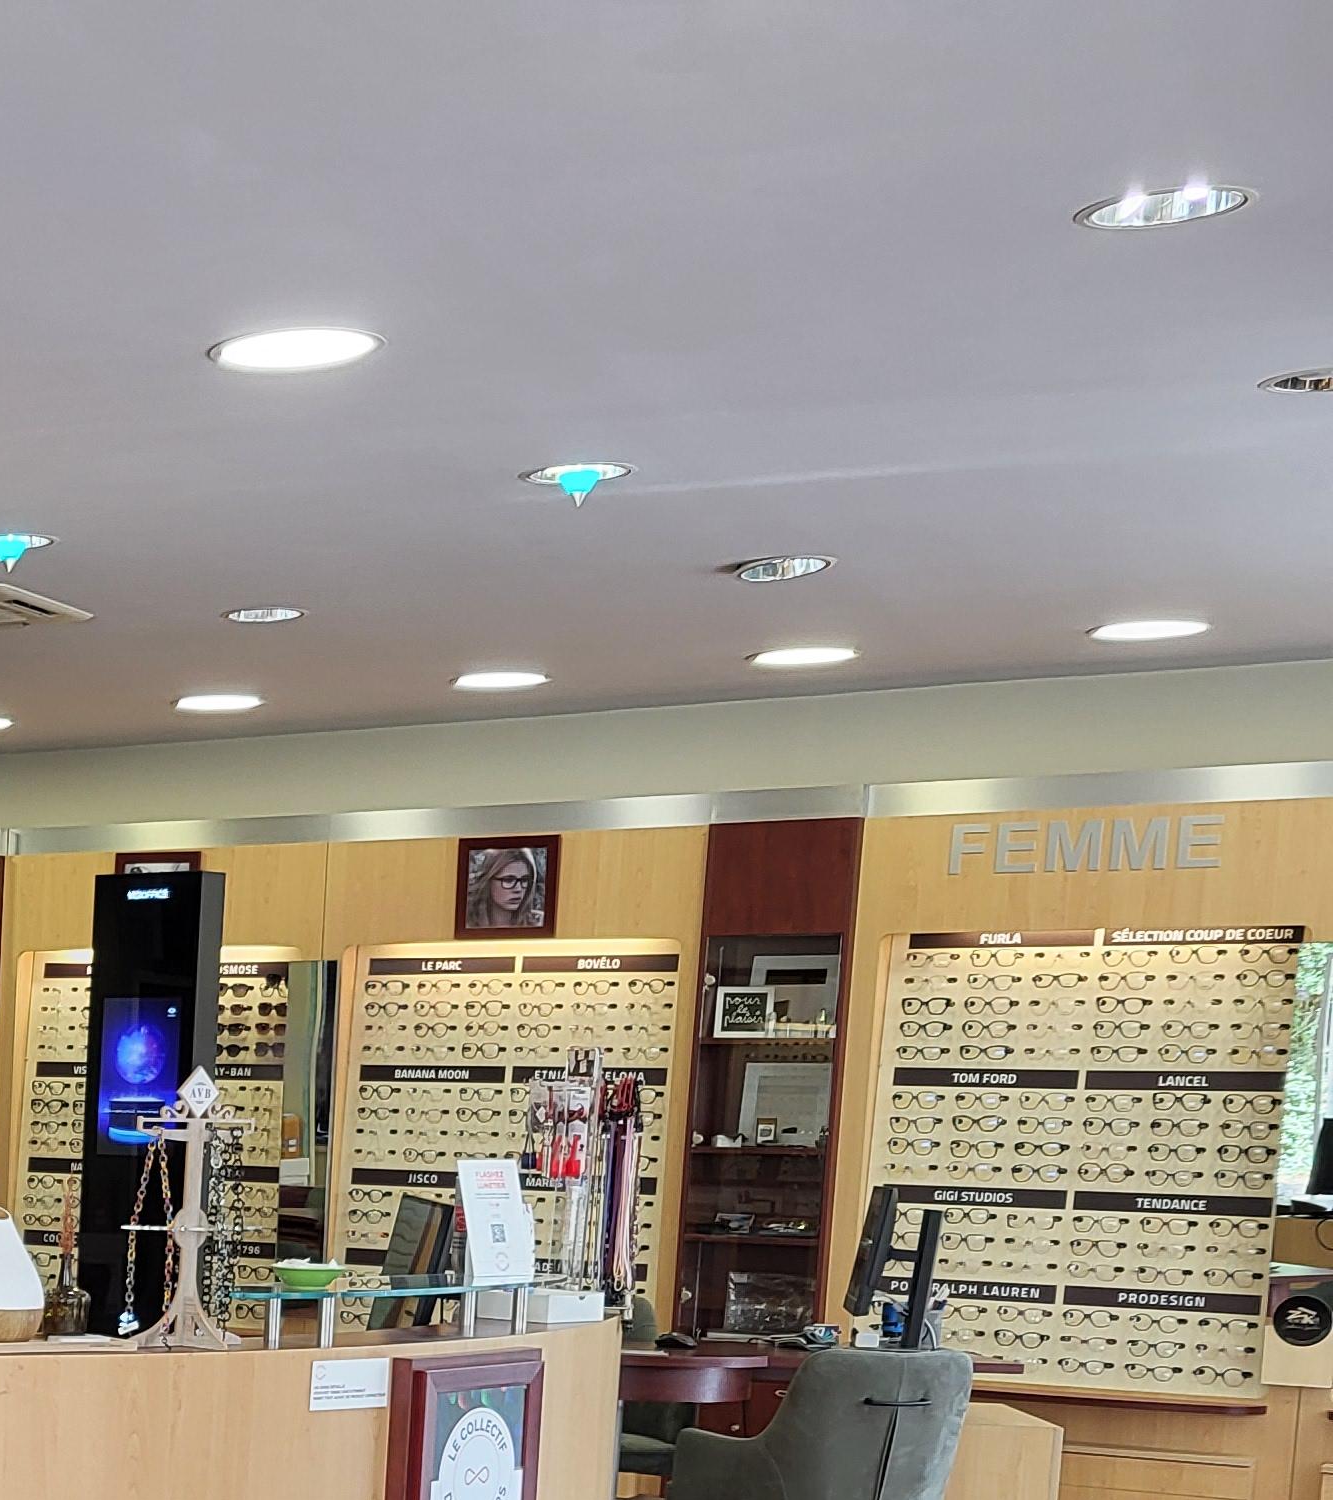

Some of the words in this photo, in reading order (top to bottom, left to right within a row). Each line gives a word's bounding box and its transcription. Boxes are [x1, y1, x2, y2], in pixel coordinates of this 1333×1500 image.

[948, 814, 1225, 875] FEMME
[978, 931, 1022, 945] FURLA
[1111, 927, 1184, 943] SÉLECTION
[1185, 929, 1221, 943] COUP
[1222, 929, 1244, 942] DE
[1246, 928, 1294, 942] COEUR
[421, 961, 434, 971] LE
[435, 959, 463, 971] PARC
[725, 996, 762, 1009] pour
[735, 1004, 751, 1017] le
[724, 1010, 764, 1028] plaisir
[394, 1068, 434, 1080] BANANA
[437, 1068, 470, 1080] MOON
[952, 1072, 980, 1084] TOM
[982, 1072, 1017, 1085] FORD
[1157, 1074, 1209, 1088] LANCEL
[189, 1088, 212, 1100] AVB
[407, 1172, 439, 1185] JISCO
[933, 1190, 959, 1203] GIGI
[959, 1190, 1014, 1204] STUDIOS
[1135, 1197, 1208, 1211] TENDANCE
[981, 1284, 1041, 1299] LAUREN
[1117, 1291, 1206, 1309] PRODESIGN
[447, 1439, 462, 1462] LE
[460, 1417, 508, 1452] COLLECTIF
